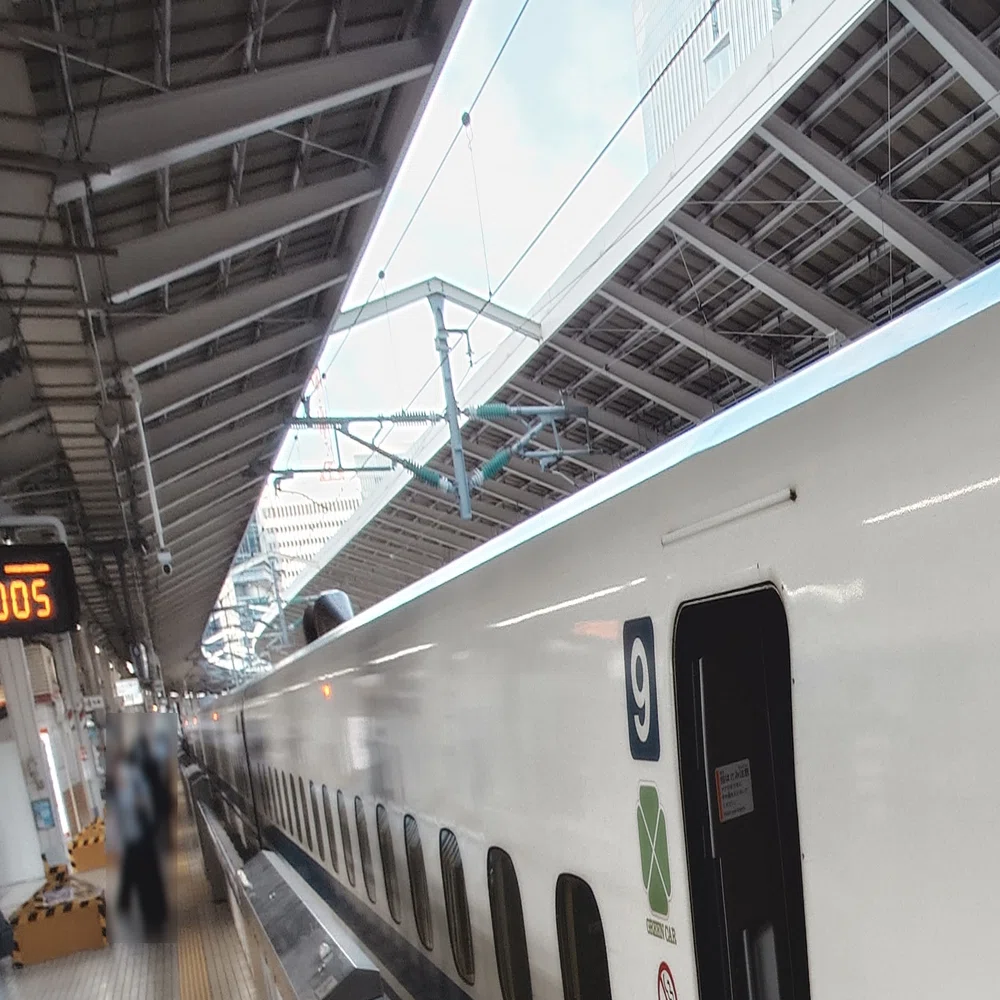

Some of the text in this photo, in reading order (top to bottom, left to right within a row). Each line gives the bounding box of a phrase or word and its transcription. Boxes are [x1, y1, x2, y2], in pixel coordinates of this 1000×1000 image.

[630, 637, 651, 743] 9
[646, 918, 677, 945] GREEN CAR
